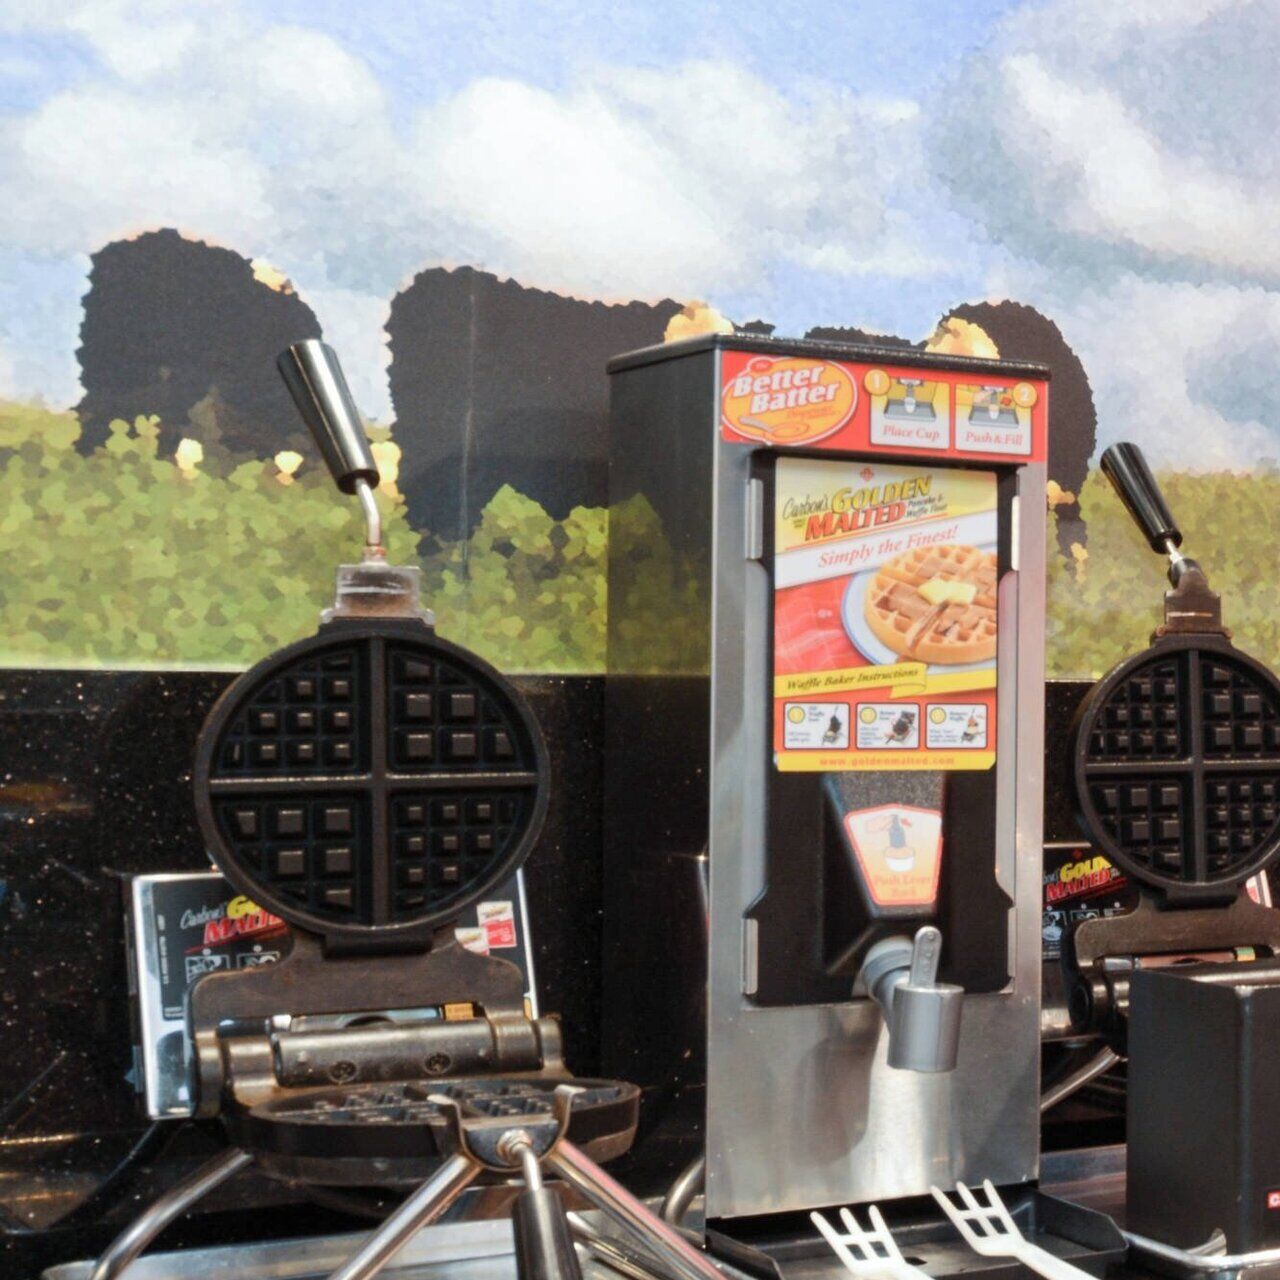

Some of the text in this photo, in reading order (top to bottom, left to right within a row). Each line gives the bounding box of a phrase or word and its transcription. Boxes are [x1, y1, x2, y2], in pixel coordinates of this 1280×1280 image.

[733, 366, 825, 397] Better
[873, 374, 881, 389] 1
[1020, 387, 1029, 402] 2
[751, 382, 840, 414] Batter
[883, 424, 940, 441] Place Cup
[965, 431, 992, 444] Push
[1005, 433, 1024, 446] Fill
[831, 475, 933, 514] GOLDEN
[805, 501, 907, 541] MALTED
[818, 525, 959, 568] Simply the Finest!
[786, 668, 919, 690] Waffle Baker Instructions
[819, 756, 955, 768] www.goldenmalted.com
[1046, 869, 1111, 902] MALTED
